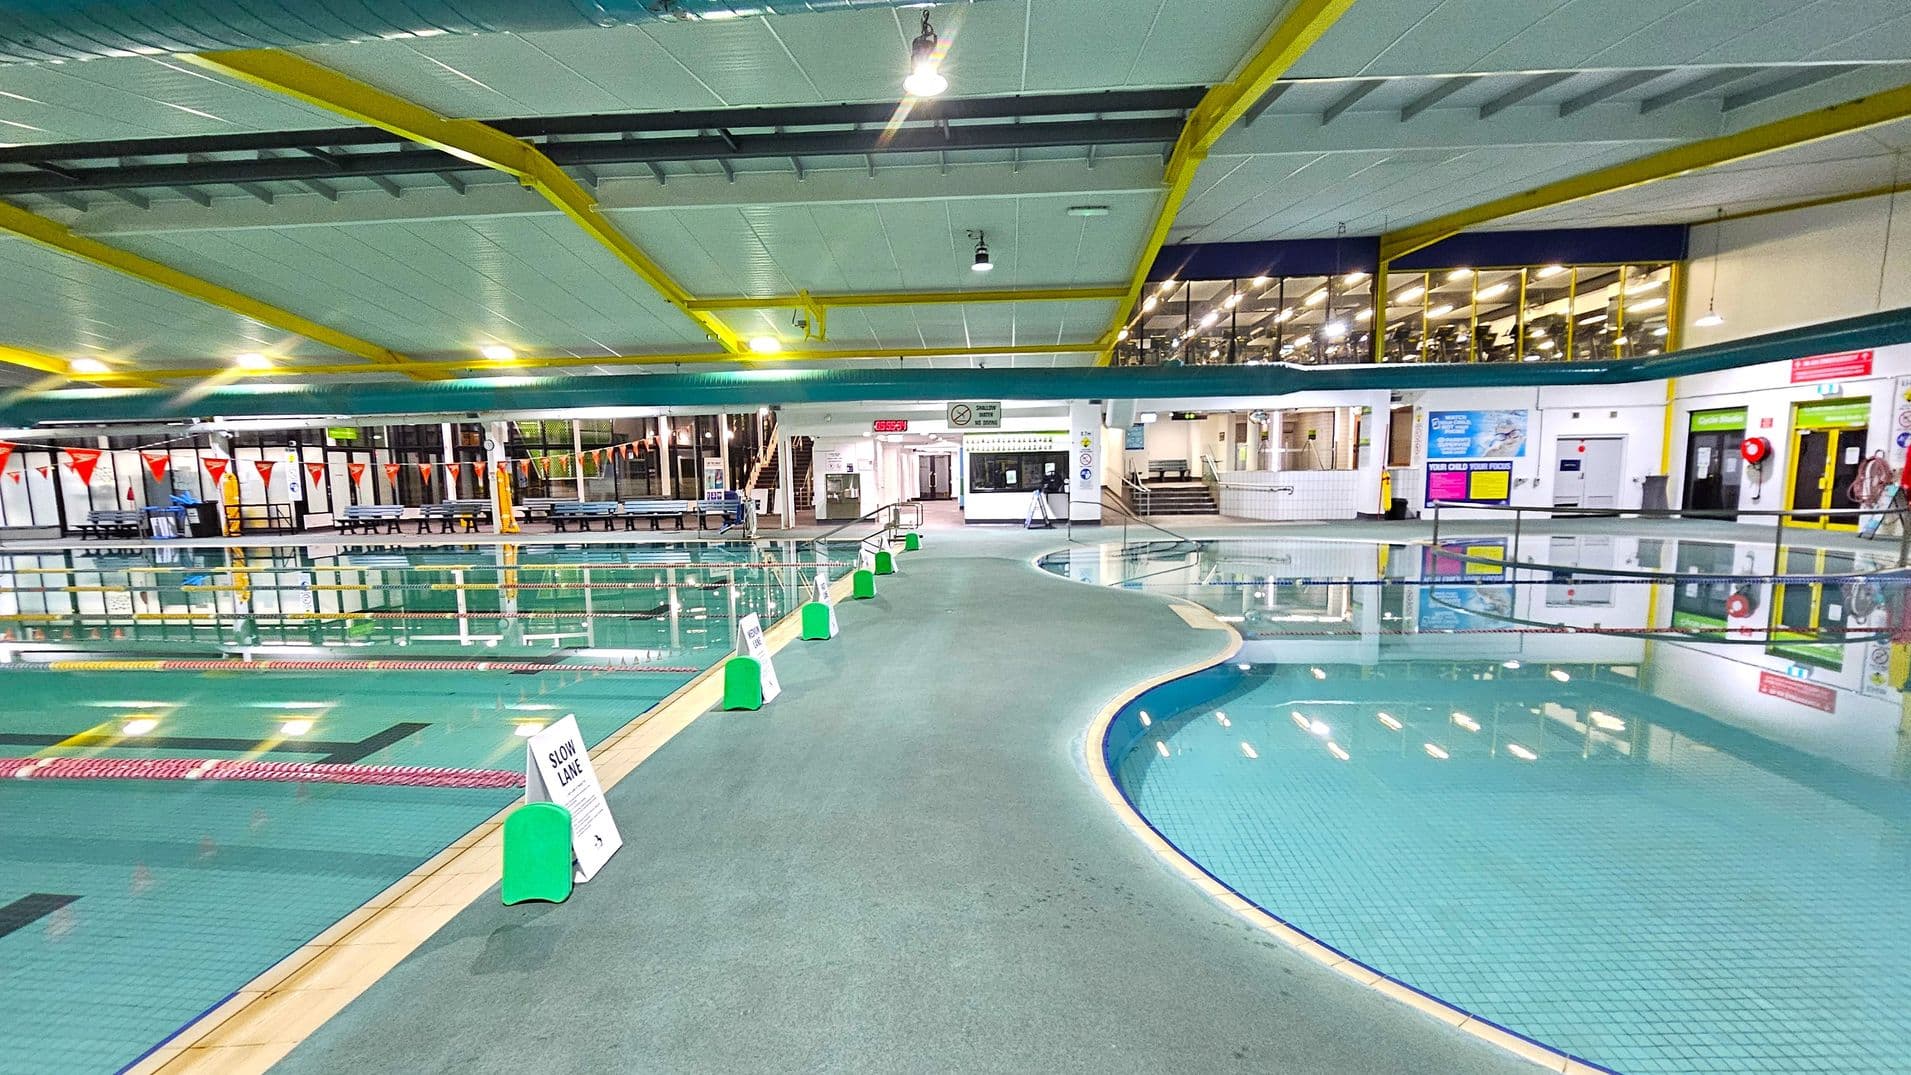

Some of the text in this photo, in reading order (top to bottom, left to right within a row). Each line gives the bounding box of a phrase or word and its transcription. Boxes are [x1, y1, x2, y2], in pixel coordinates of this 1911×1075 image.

[1429, 463, 1447, 471] YOUR
[548, 738, 577, 769] SLOW
[557, 758, 583, 787] LANE
